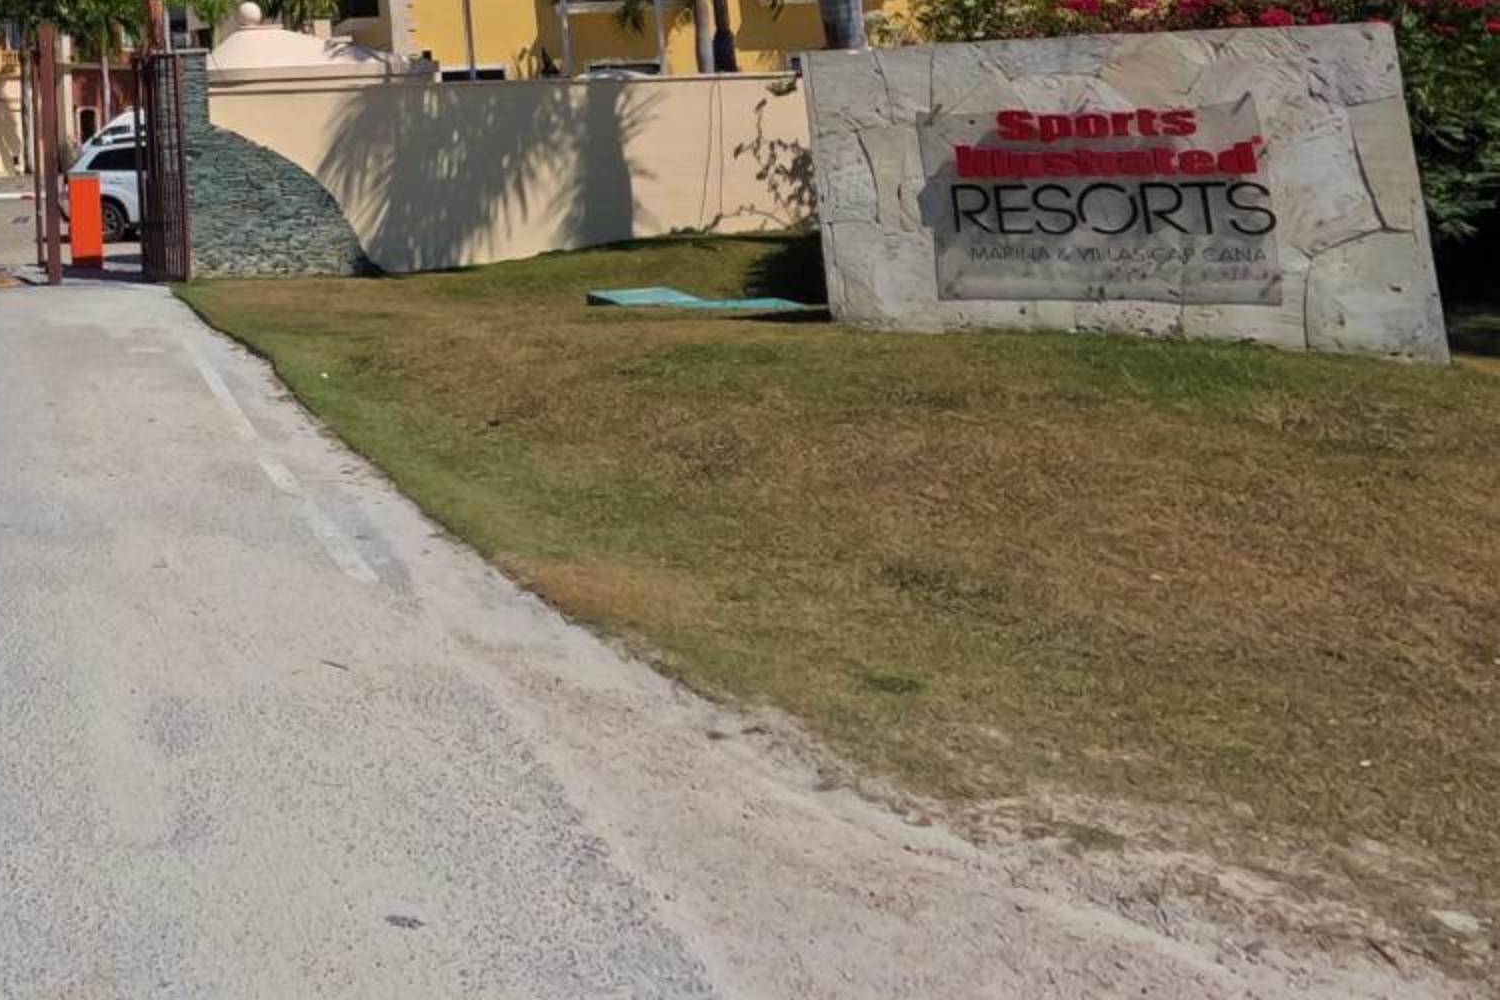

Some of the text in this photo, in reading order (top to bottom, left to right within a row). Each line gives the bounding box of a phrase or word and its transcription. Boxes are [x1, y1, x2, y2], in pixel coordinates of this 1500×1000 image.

[996, 109, 1197, 142] Sports
[951, 181, 1277, 235] RESORTS
[969, 247, 1049, 263] MARINA
